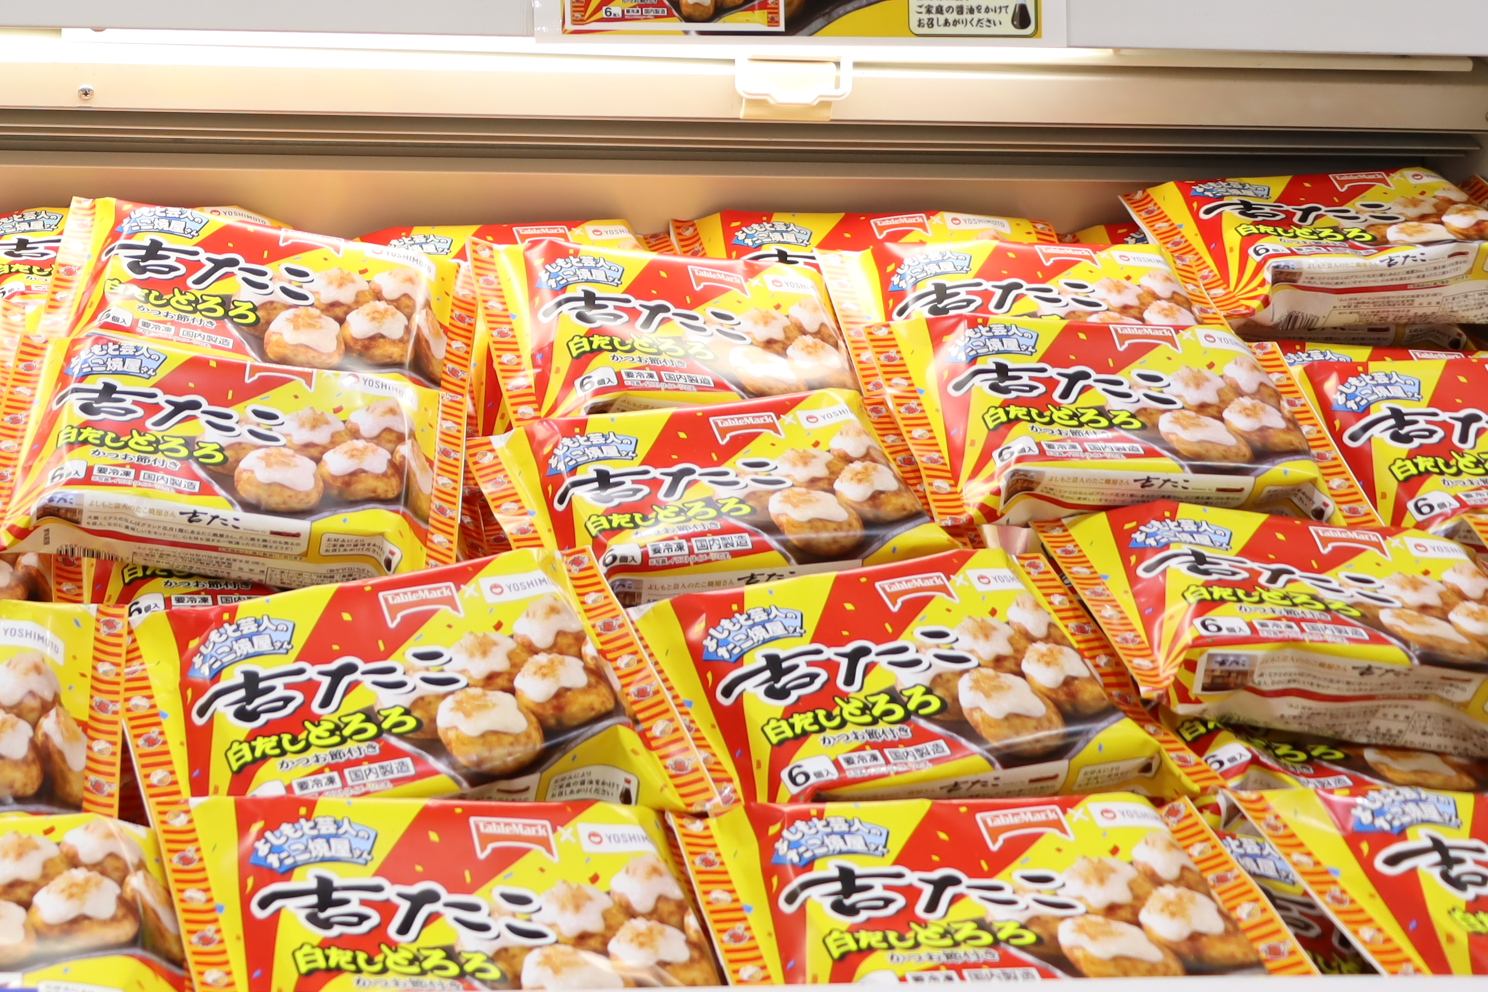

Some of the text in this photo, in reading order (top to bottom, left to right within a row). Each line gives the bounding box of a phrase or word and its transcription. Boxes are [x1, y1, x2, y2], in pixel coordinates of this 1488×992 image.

[917, 18, 1002, 28] お召しあがりください
[962, 217, 1008, 230] YOSHIMOTO
[1200, 199, 1405, 226] 吉たこ
[1236, 225, 1377, 242] 白だしとろろ
[103, 237, 315, 306] 吉たこ
[103, 278, 261, 325] 白だしとろろ
[135, 303, 218, 328] かつお節付き
[541, 288, 753, 345] 吉たこ
[180, 328, 233, 349] 国内製造
[1113, 326, 1173, 339] TableMark
[662, 372, 715, 388] 国内製造
[949, 359, 1185, 409] 吉たこ
[54, 381, 287, 446] 吉たこ
[714, 413, 775, 430] TableMark
[984, 405, 1147, 430] 白だしとろろ
[56, 426, 229, 463] 白だしとろろ
[89, 447, 180, 470] かつお節付き
[143, 470, 200, 492] 国内製造
[553, 458, 793, 511] 吉たこ
[1133, 474, 1191, 491] 吉たこ
[179, 510, 242, 531] 吉たこ
[585, 496, 756, 538] 白だしとろろ
[648, 533, 751, 555] 要冷凍 国内製造
[881, 575, 949, 596] TableMark
[1136, 546, 1402, 608] 吉たこ
[385, 585, 454, 605] TableMark
[1183, 584, 1363, 618] 白だしとろろ
[1, 623, 61, 655] YOSHIMOTO
[715, 626, 979, 706] 吉たこ
[191, 647, 470, 729] 吉たこ
[762, 686, 944, 747] 白だしとろろ
[225, 707, 425, 775] 白だしとろろ
[276, 741, 381, 772] かつお節付き
[347, 757, 416, 786] 国内製造
[475, 821, 550, 839] TableMark
[983, 808, 1065, 828] TableMark
[255, 872, 558, 942] 吉たこ
[780, 863, 1089, 921] 吉たこ
[824, 920, 1043, 961] 白だしとろろ
[294, 943, 506, 982] 白だしとろろ
